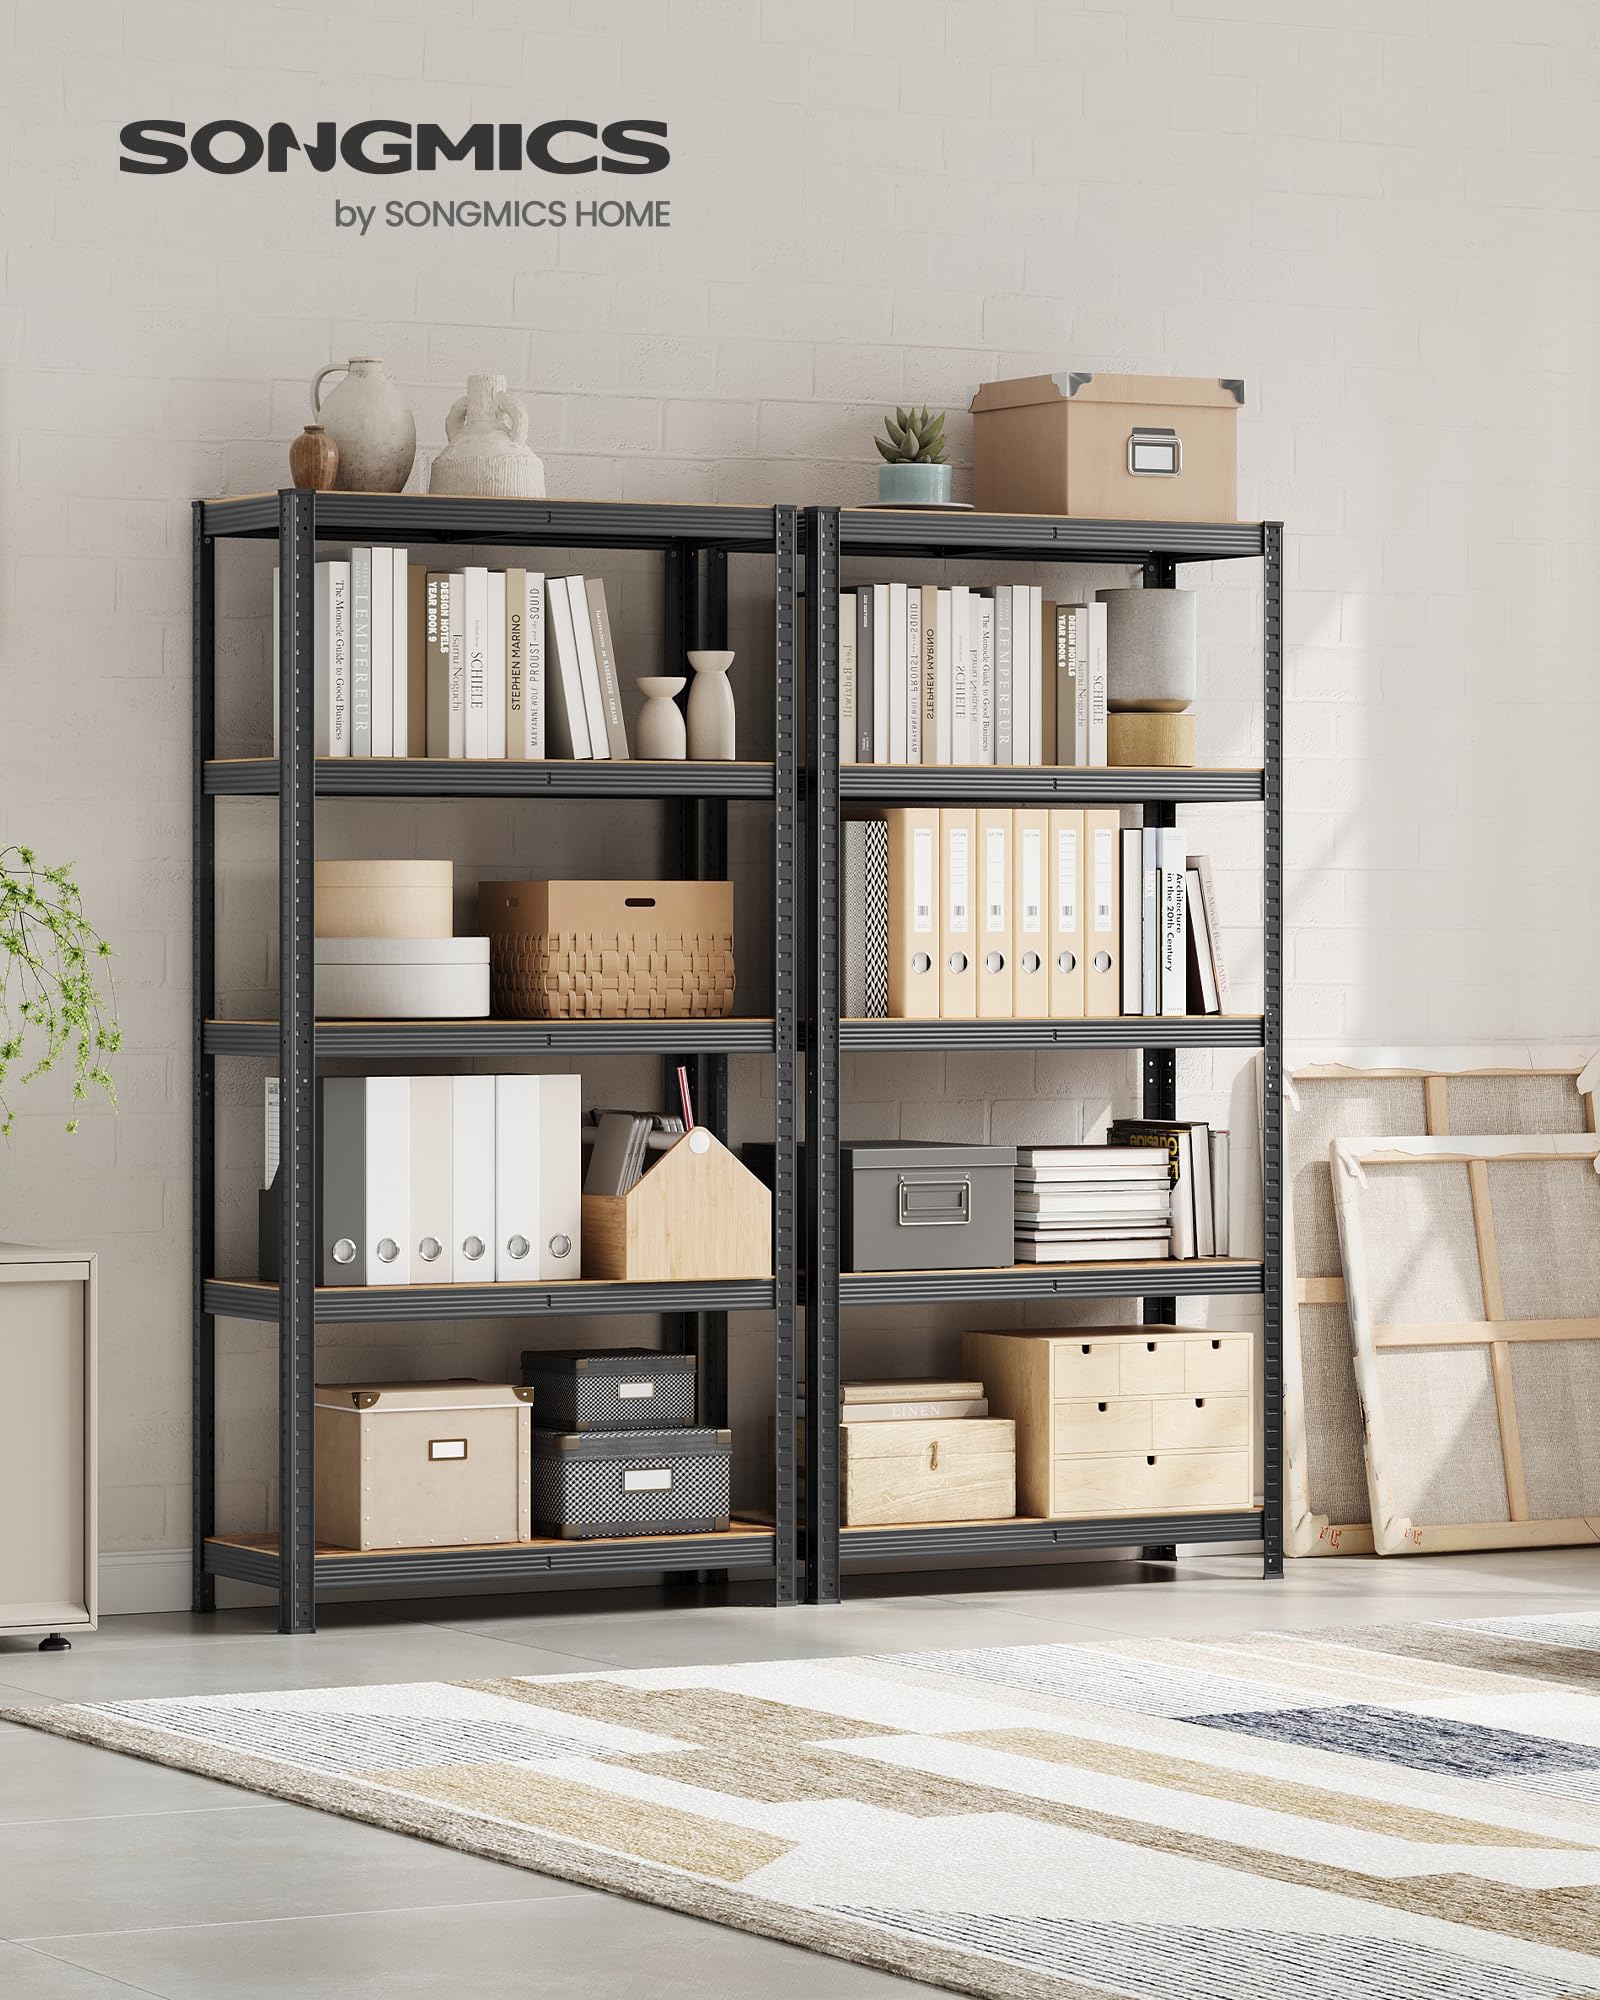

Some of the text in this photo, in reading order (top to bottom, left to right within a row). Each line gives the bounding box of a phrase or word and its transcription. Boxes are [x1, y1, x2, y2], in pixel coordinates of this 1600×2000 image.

[428, 582, 438, 606] YEAR
[428, 608, 438, 634] BOOK
[440, 582, 449, 654] DESIGN HOTELS
[529, 588, 540, 620] SQUID
[1058, 615, 1066, 636] YEAR
[1058, 638, 1066, 660] BOOK
[1068, 615, 1076, 677] DESIGN HOTELS
[335, 580, 345, 741] The Monocle Guide to Good Business
[355, 594, 369, 732] LEMPEREUR
[450, 634, 463, 712] Isamu Noguchi
[470, 651, 483, 709] SCHIELE
[511, 614, 521, 711] STEPHEN MARINO
[529, 642, 540, 682] PROUST
[982, 613, 990, 752] The Monocle Guide to Good Business
[998, 626, 1010, 745] LEMPEREUR
[1076, 660, 1087, 727] Isamu Noguchi
[1092, 675, 1104, 725] SCHIELE
[1164, 873, 1175, 972] in the 20th Century
[1176, 873, 1184, 934] Architecture
[1206, 896, 1218, 930] Monocle
[1212, 931, 1220, 952] Book
[1217, 964, 1228, 993] JAPAN
[892, 1404, 941, 1417] LINEN
